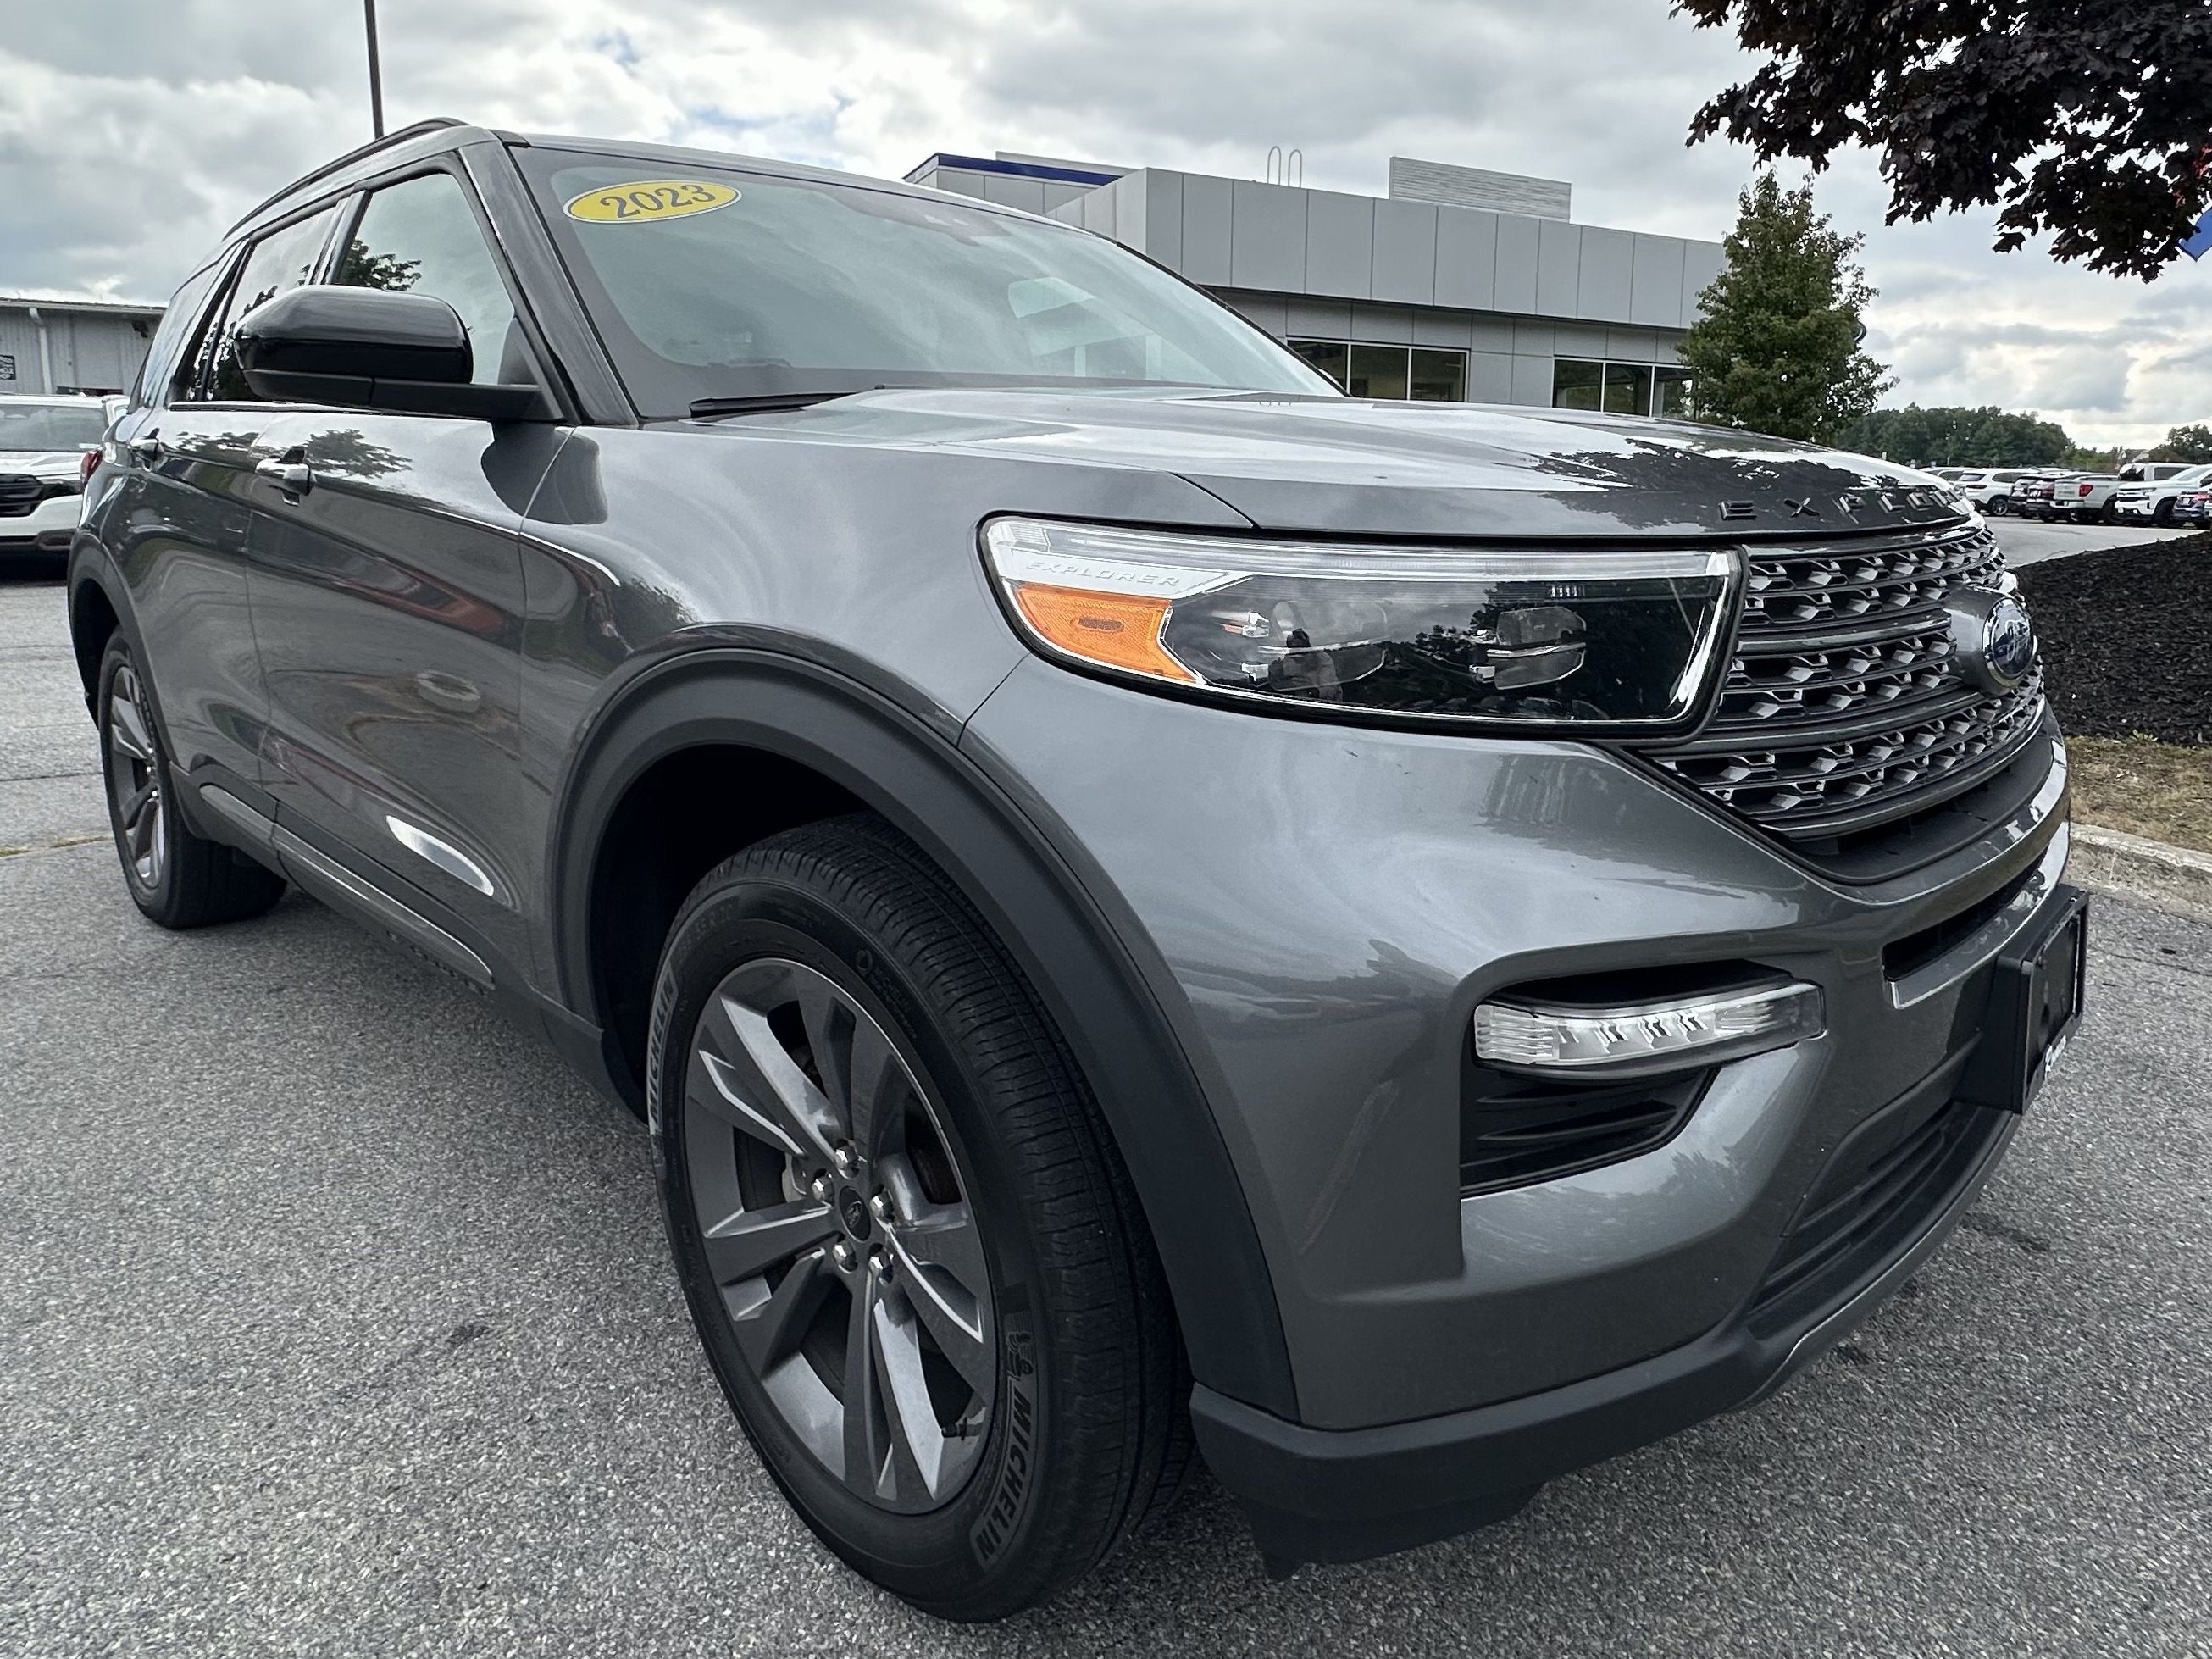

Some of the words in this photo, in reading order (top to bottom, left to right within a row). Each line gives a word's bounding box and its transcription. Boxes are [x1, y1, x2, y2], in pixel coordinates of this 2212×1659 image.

[600, 184, 716, 218] 2023
[1718, 489, 1960, 521] EXPLO
[1026, 562, 1180, 586] EXPLORER
[975, 1385, 1033, 1561] MICHELIN
